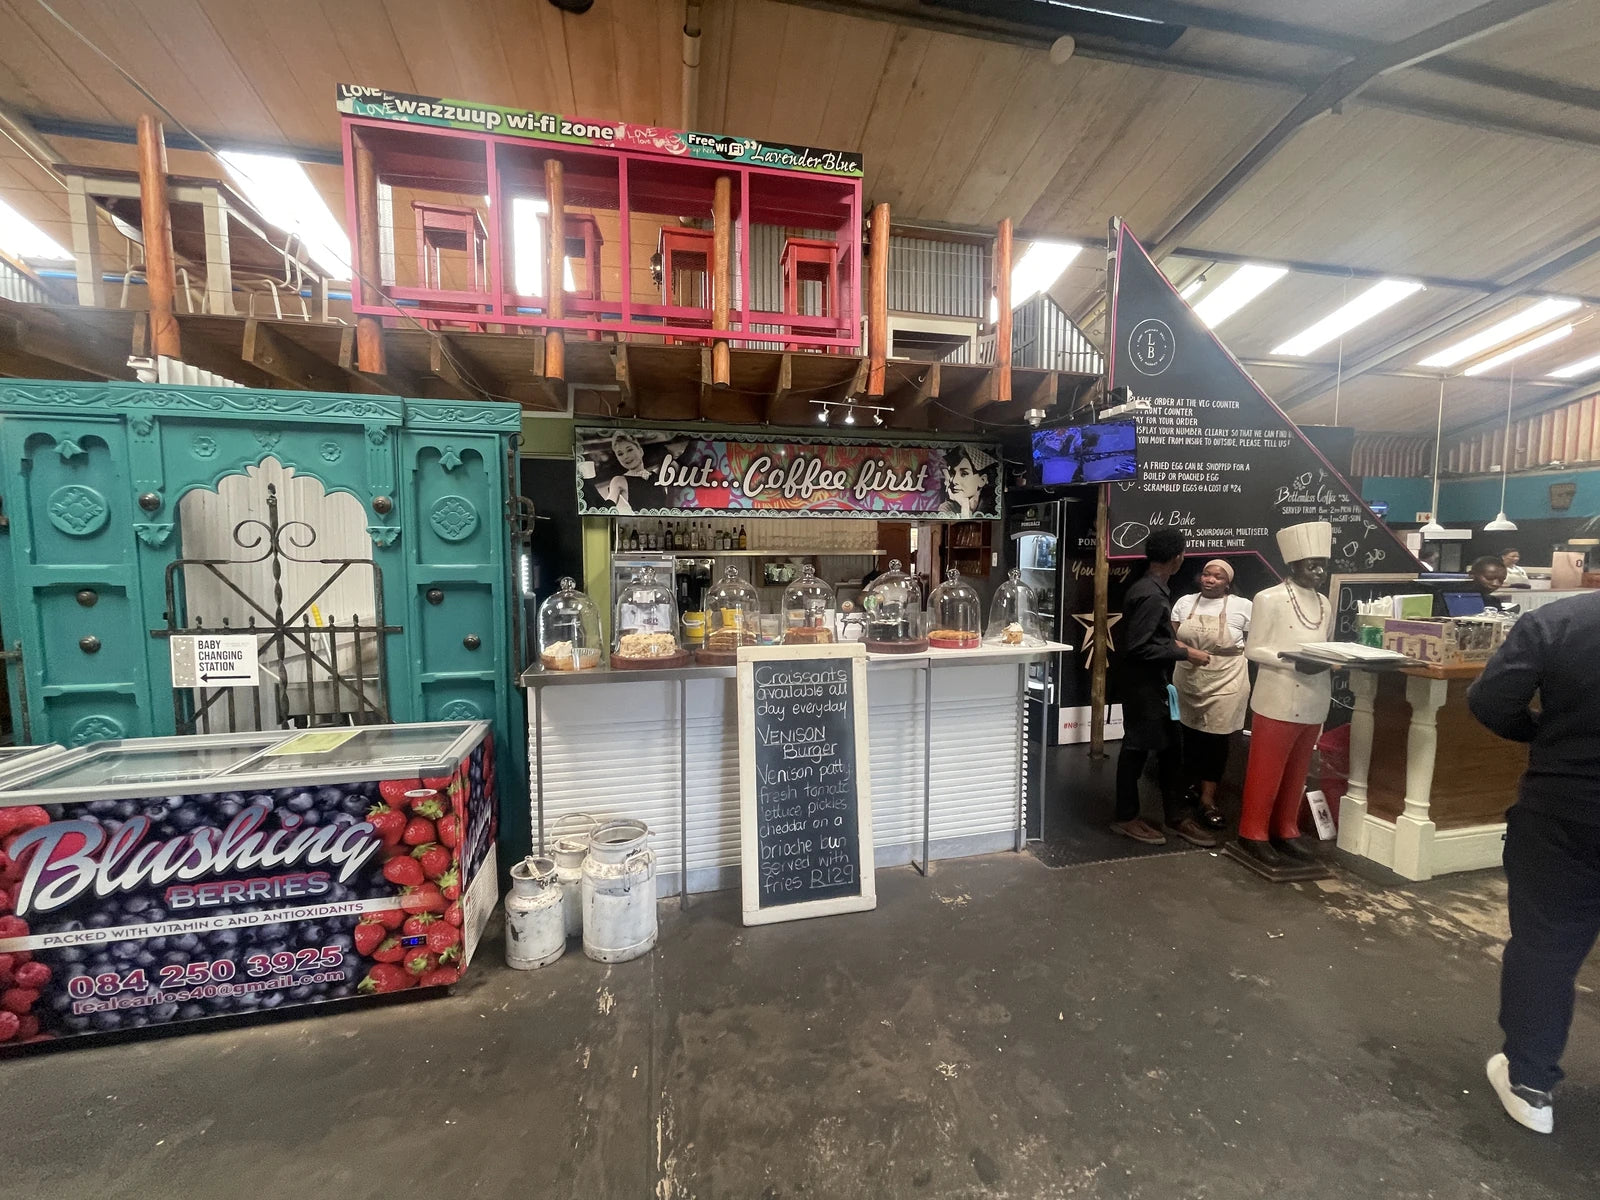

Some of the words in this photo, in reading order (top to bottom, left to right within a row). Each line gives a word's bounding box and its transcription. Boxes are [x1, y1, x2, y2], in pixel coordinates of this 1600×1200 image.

[395, 99, 501, 128] wazzuup
[507, 114, 556, 133] wi-fi
[561, 122, 614, 140] zone
[688, 134, 716, 146] Free
[1154, 397, 1175, 406] ORDER
[1176, 399, 1184, 407] AT
[1186, 399, 1197, 407] THE
[1212, 400, 1240, 409] COUNTER
[1164, 408, 1193, 417] COUNTER
[1146, 417, 1157, 425] FOR
[1176, 418, 1198, 426] ORDER
[1136, 426, 1157, 435] ISPLAY
[1159, 427, 1174, 435] YOUR
[1176, 427, 1202, 436] NUMBER
[1205, 428, 1229, 437] CLEARLY
[1231, 429, 1239, 437] SO
[1240, 429, 1252, 438] THAT
[1254, 430, 1262, 438] WE
[1264, 430, 1274, 438] CAN
[1137, 436, 1149, 444] YOU
[1150, 437, 1165, 445] MOVE
[1168, 437, 1184, 445] FROM
[1185, 437, 1203, 446] INSIDE
[1204, 438, 1212, 446] TO
[1240, 439, 1261, 447] PLEASE
[1264, 439, 1277, 447] TELL
[1143, 462, 1149, 470] A
[1150, 462, 1169, 470] FRIED
[1171, 462, 1183, 470] EGG
[1185, 462, 1196, 470] CAN
[1233, 463, 1244, 471] FOR
[1245, 463, 1251, 471] A
[853, 459, 929, 500] first
[1143, 472, 1166, 481] BOILED
[1168, 472, 1177, 481] OR
[1178, 472, 1205, 481] POACHED
[1206, 473, 1220, 481] EGG
[1143, 484, 1181, 492] SCRAMBLED
[1209, 484, 1221, 492] COST
[1223, 484, 1229, 492] OF
[1149, 511, 1164, 526] We
[1168, 510, 1196, 526] Bake
[1282, 506, 1302, 515] SERVED
[1302, 506, 1316, 514] FROM
[1186, 539, 1205, 548] UTEN
[198, 640, 221, 650] BABY
[198, 650, 243, 661] CHANGING
[199, 661, 235, 672] STATION
[755, 666, 848, 686] Croissants
[756, 685, 823, 700] available
[828, 683, 848, 696] all
[757, 701, 785, 721] day
[792, 700, 848, 719] everyday
[757, 724, 826, 745] VENISON
[783, 743, 838, 764] Burger
[757, 764, 813, 785] Venison
[760, 785, 798, 804] fresh
[808, 797, 848, 817] pickles
[760, 819, 807, 838] cheddar
[812, 818, 829, 829] on
[834, 816, 843, 826] a
[761, 838, 813, 860] brioche
[820, 834, 847, 850] bun
[9, 806, 381, 917] Blushing
[761, 855, 810, 876] served
[818, 850, 849, 867] with
[764, 875, 803, 894] fries
[809, 864, 854, 888] R129
[168, 873, 331, 909] BERRIES
[43, 931, 107, 946] PACKED
[111, 926, 149, 938] WITH
[153, 921, 209, 934] VITAMIN
[213, 918, 223, 928] C
[228, 915, 259, 926] AND
[262, 902, 364, 921] ANTIOXIDANTS
[68, 968, 149, 999] 084
[159, 959, 235, 989] 250
[246, 945, 344, 977] 3925
[72, 969, 345, 1015] lealcarlos40@gmail.com
